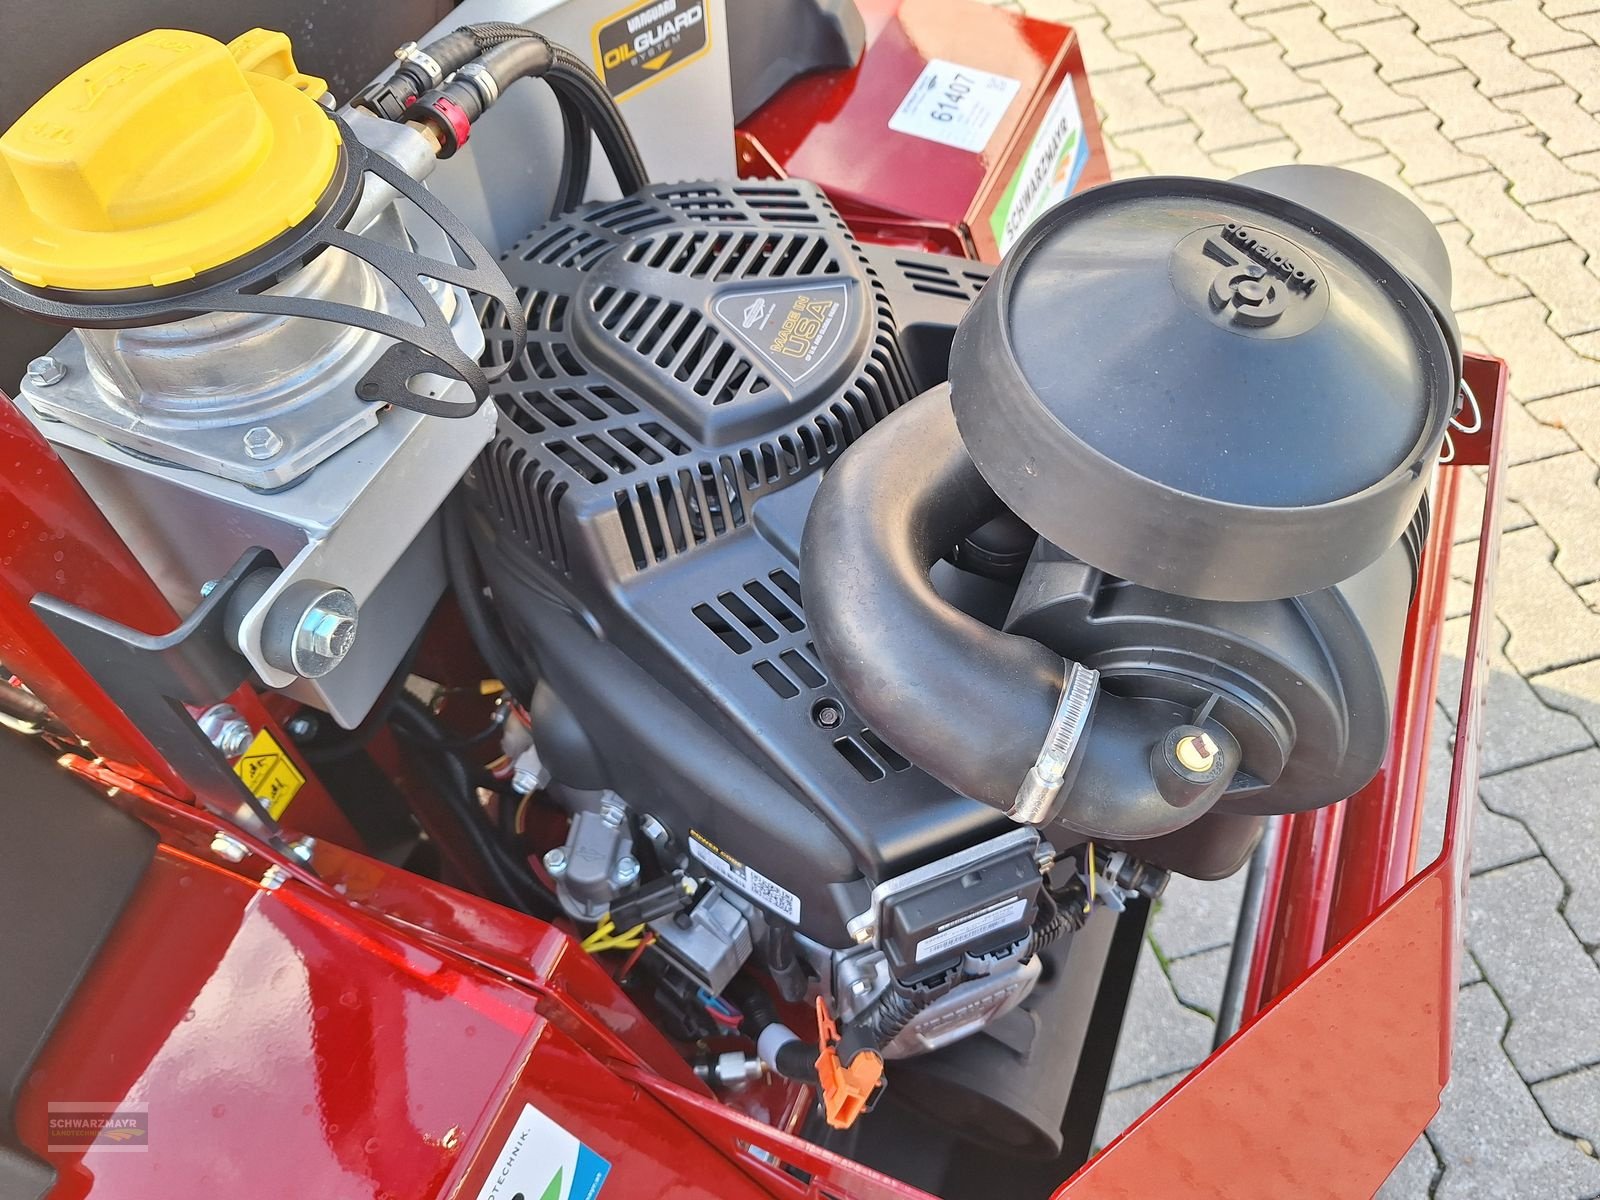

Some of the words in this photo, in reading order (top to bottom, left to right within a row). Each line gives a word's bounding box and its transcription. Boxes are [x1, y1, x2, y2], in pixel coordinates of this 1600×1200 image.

[931, 73, 975, 123] 61407
[1006, 117, 1069, 242] SCHWARZMAYR
[770, 309, 800, 352] MADE
[793, 295, 810, 312] IN
[782, 301, 833, 358] USA
